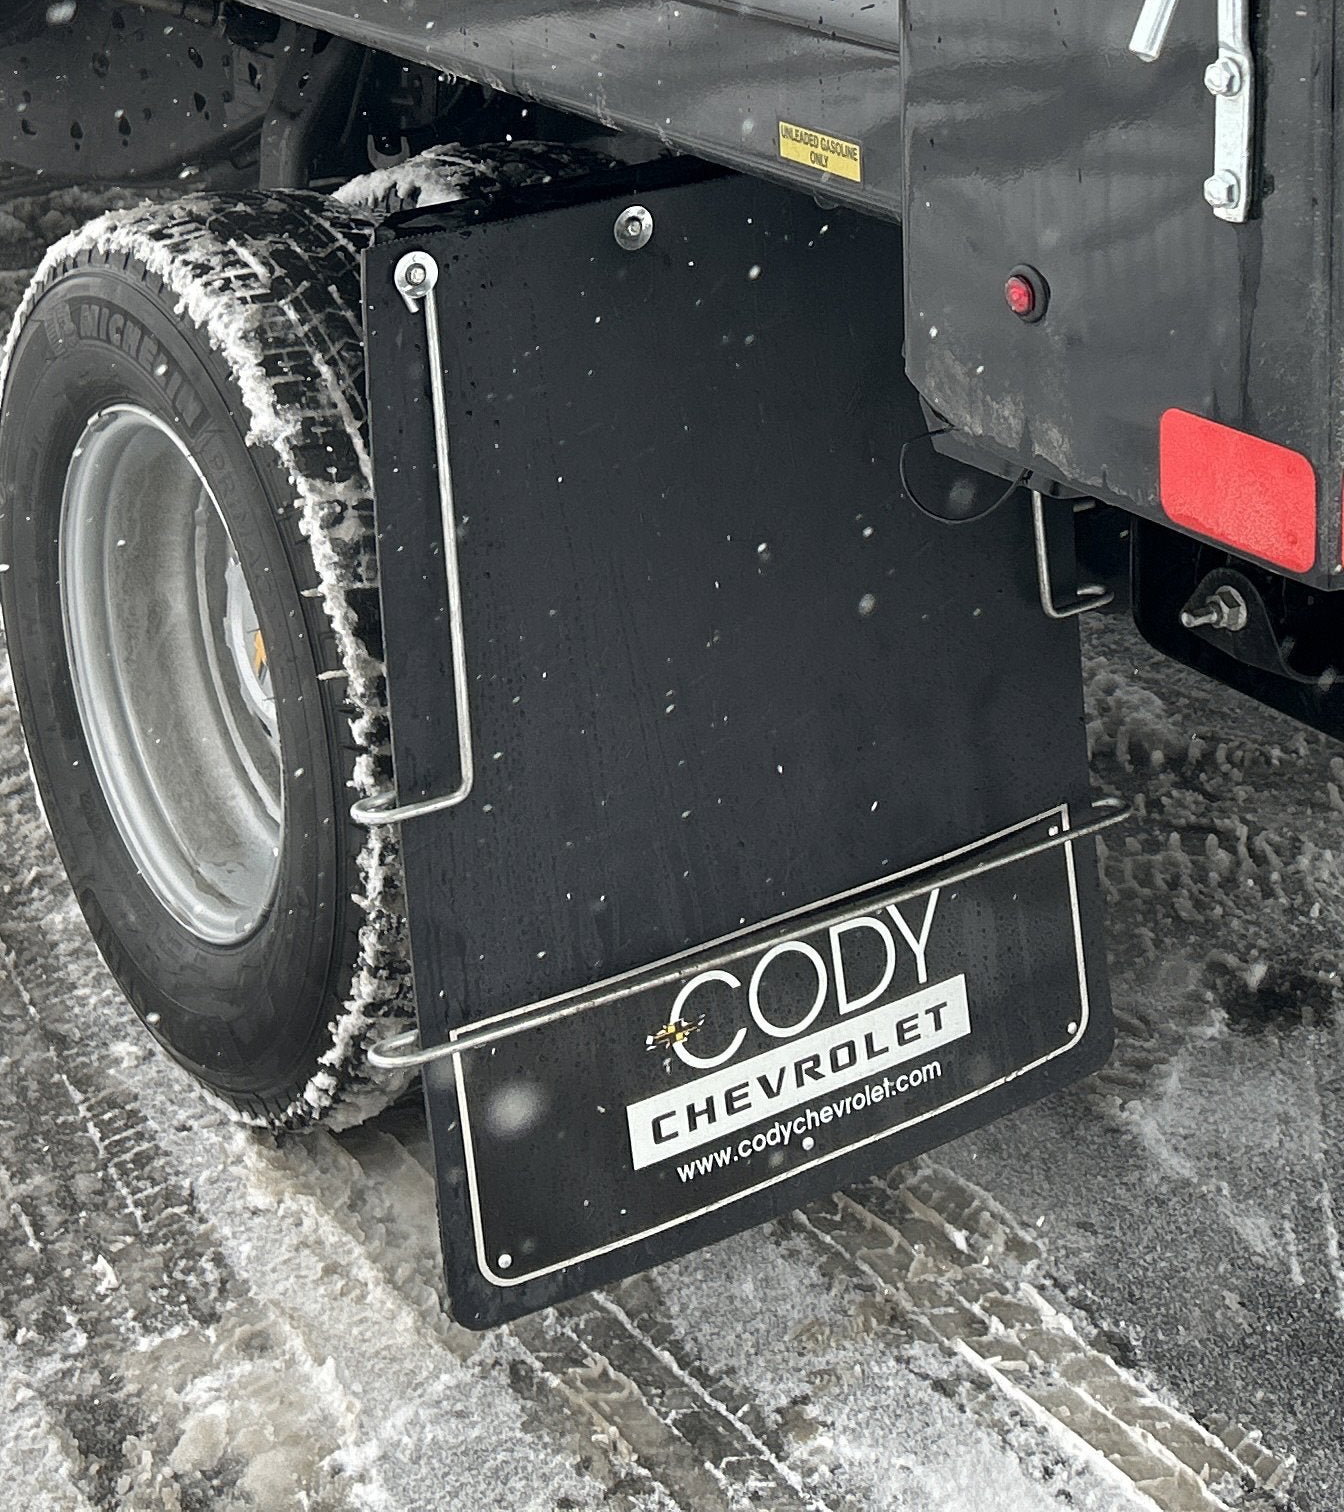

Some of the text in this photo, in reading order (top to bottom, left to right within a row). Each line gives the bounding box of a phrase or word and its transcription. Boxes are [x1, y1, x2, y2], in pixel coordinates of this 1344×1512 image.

[781, 125, 859, 161] UNLEADED GASOLINE
[809, 151, 829, 168] ONLY
[670, 889, 941, 1069] CODY
[650, 999, 952, 1147] CHEVROLET
[676, 1059, 943, 1183] www.codychevrolet.com
